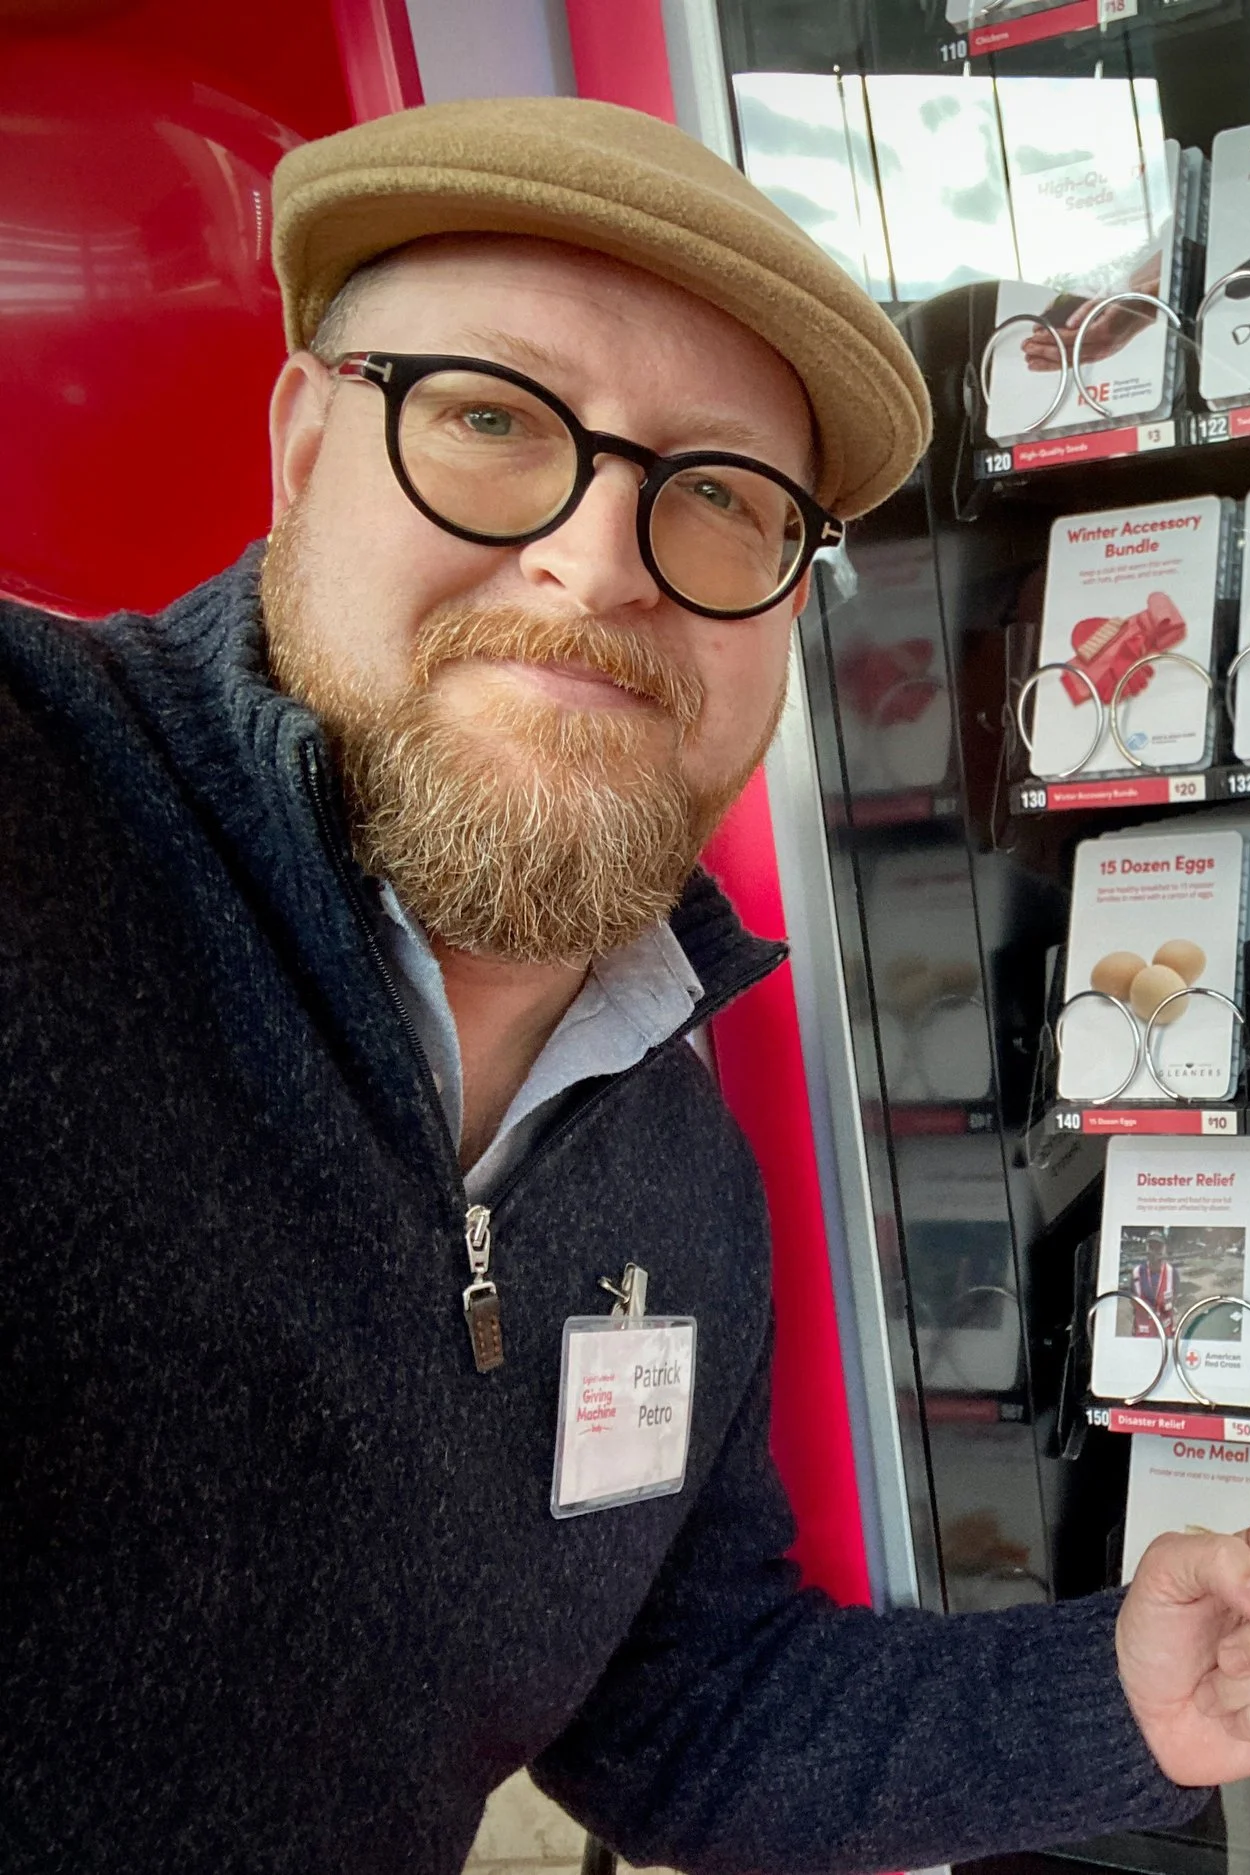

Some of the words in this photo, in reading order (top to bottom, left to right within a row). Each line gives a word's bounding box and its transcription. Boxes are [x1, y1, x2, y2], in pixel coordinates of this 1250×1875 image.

[940, 40, 967, 62] 110
[1148, 429, 1161, 442] $3
[1200, 417, 1227, 437] 122
[986, 453, 1012, 473] 120
[1068, 527, 1118, 543] Winter
[1121, 516, 1201, 536] Accessory
[1105, 539, 1159, 558] Bundle
[1172, 783, 1196, 798] $20
[1022, 791, 1046, 808] 130
[1101, 861, 1116, 874] 15
[1122, 859, 1170, 873] Dozen
[1176, 856, 1214, 875] Eggs
[1057, 1114, 1080, 1129] 140
[1208, 1117, 1227, 1129] $10
[1138, 1173, 1193, 1186] Disaster
[1196, 1173, 1235, 1186] Relief
[634, 1360, 681, 1389] Patrick
[583, 1388, 612, 1405] Giving
[576, 1407, 616, 1422] Machine
[638, 1404, 672, 1428] Petro
[1086, 1410, 1110, 1427] 150
[1118, 1415, 1156, 1426] Disaster
[1159, 1419, 1185, 1429] Relief
[1232, 1423, 1250, 1436] $50
[1173, 1442, 1205, 1459] One
[1209, 1445, 1249, 1462] Meal
